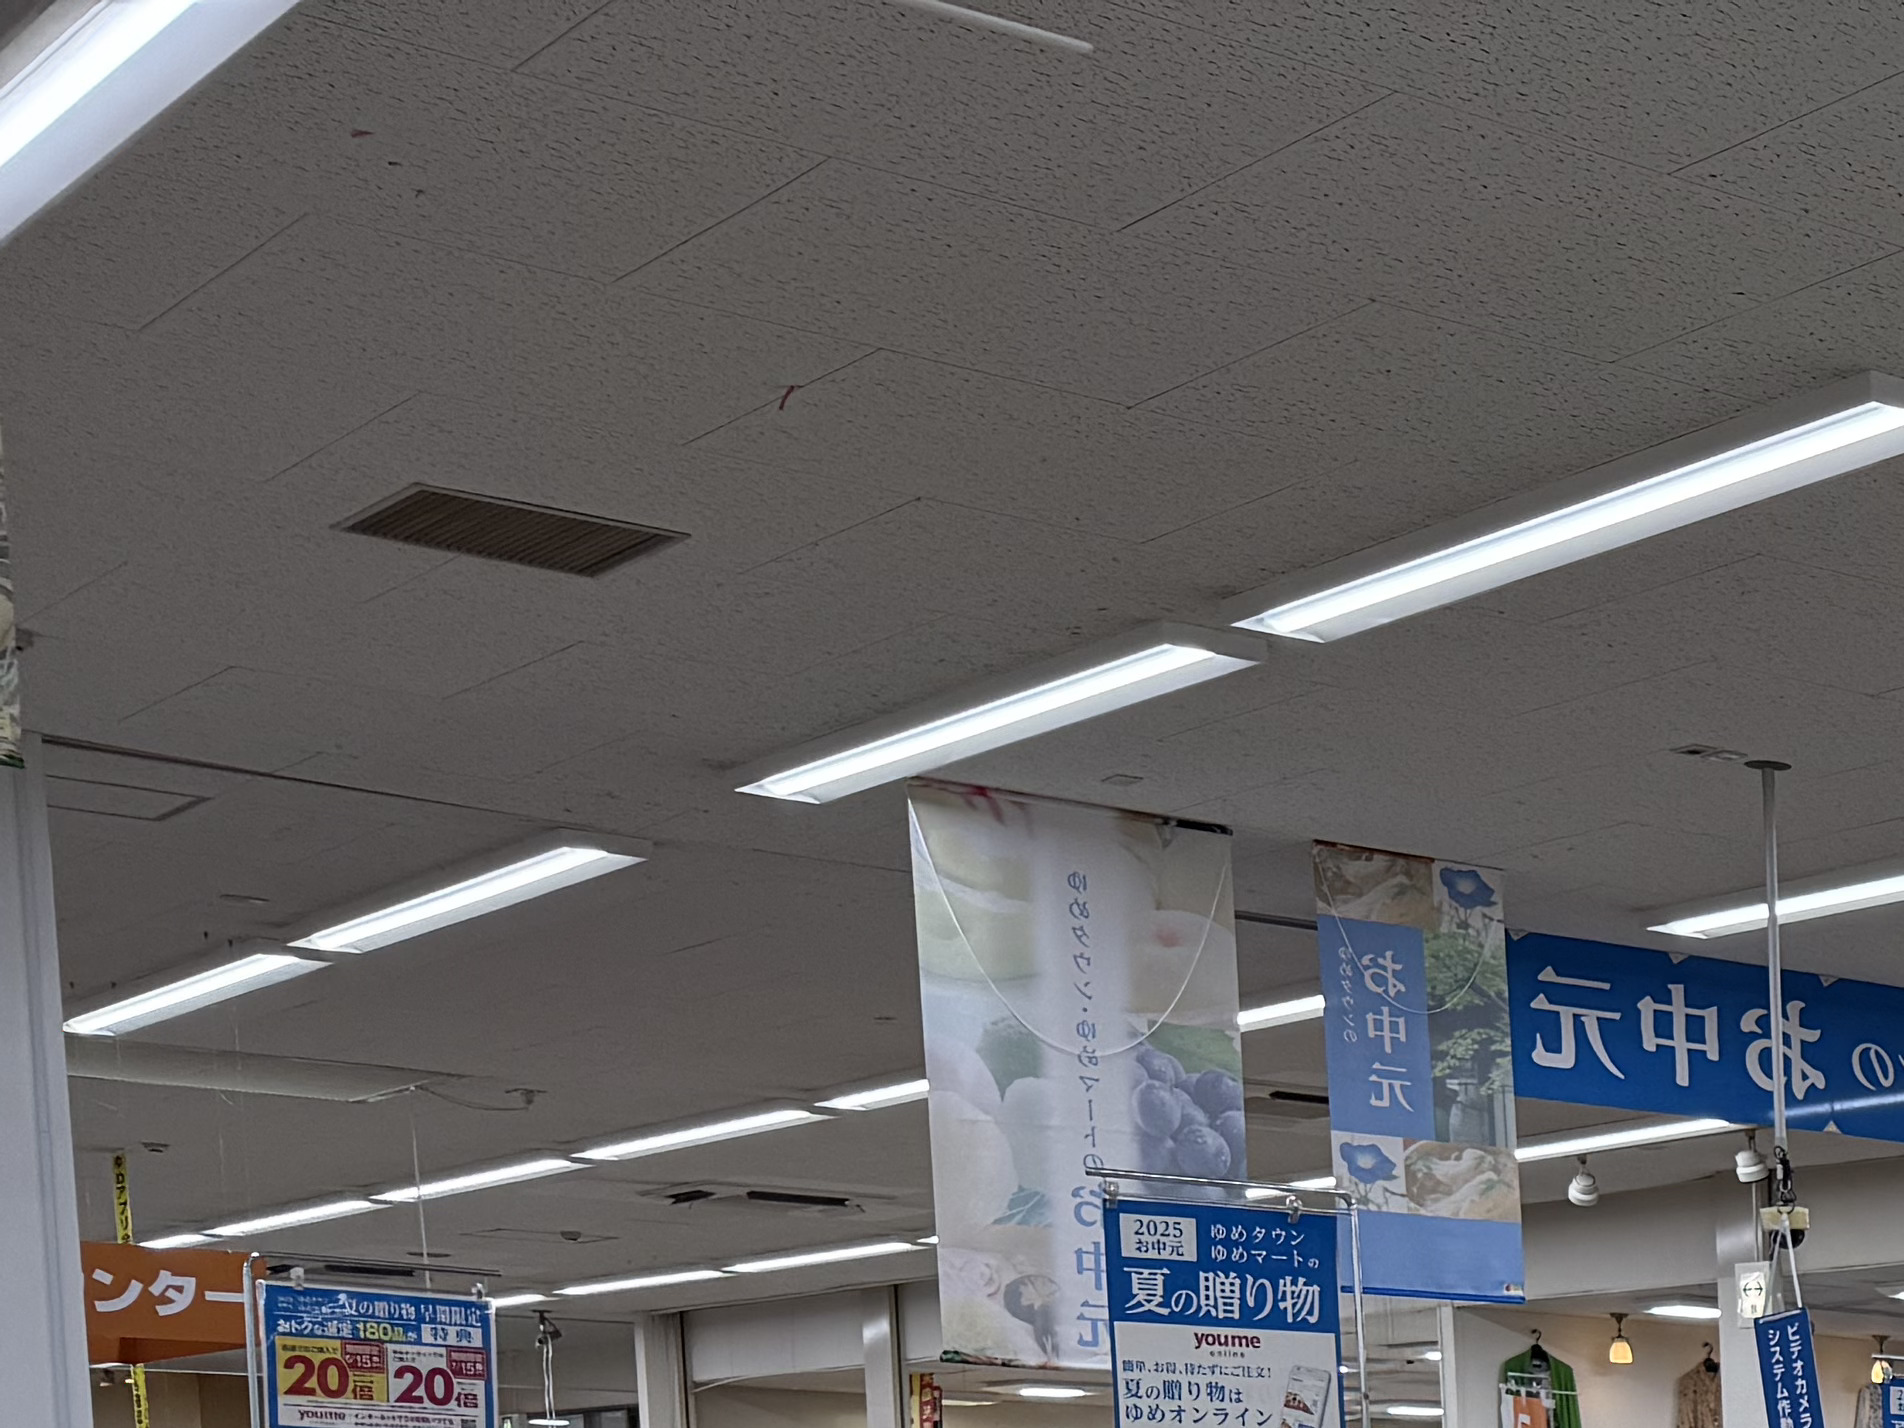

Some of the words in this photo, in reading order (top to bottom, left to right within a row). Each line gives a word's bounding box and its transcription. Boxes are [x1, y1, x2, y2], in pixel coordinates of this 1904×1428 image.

[1134, 1219, 1183, 1238] 2025
[1211, 1224, 1305, 1245] ゆめタウン
[1135, 1238, 1184, 1257] お中元
[1211, 1244, 1320, 1268] ゆめマートの
[1123, 1267, 1320, 1324] 夏の贈り物
[1194, 1332, 1260, 1350] youme
[1122, 1378, 1244, 1404] 夏の贈り物は
[1125, 1404, 1273, 1427] ゆめオンライン
